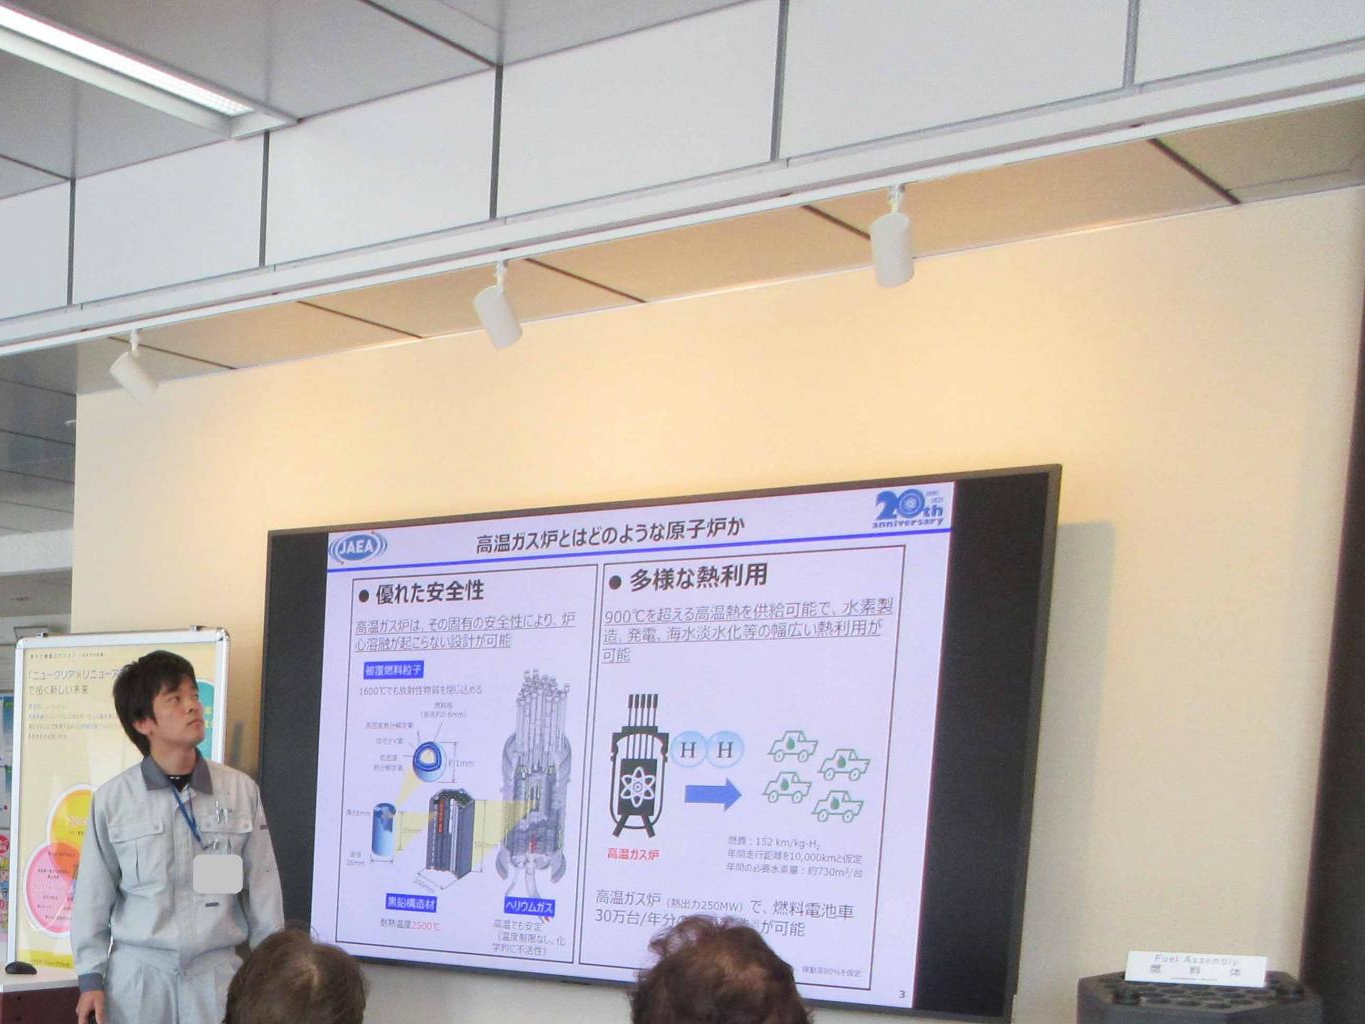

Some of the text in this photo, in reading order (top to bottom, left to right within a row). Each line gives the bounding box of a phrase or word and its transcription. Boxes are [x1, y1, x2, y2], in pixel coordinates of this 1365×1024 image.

[872, 515, 944, 529] anniversary
[476, 516, 745, 554] 高温ガス炉とはどのような原子炉か
[338, 538, 374, 555] JAEA
[630, 562, 768, 592] 多様な熱利用
[375, 579, 484, 605] 優れた安全性
[354, 633, 512, 650] 心溶融が起こらない設計が可能
[602, 647, 631, 663] 可能
[680, 741, 696, 759] H
[717, 741, 733, 759] H
[607, 847, 660, 861] 高温ガス炉
[505, 900, 554, 915] ヘリウムガス
[1154, 954, 1179, 963] Fuel
[898, 990, 906, 999] 3
